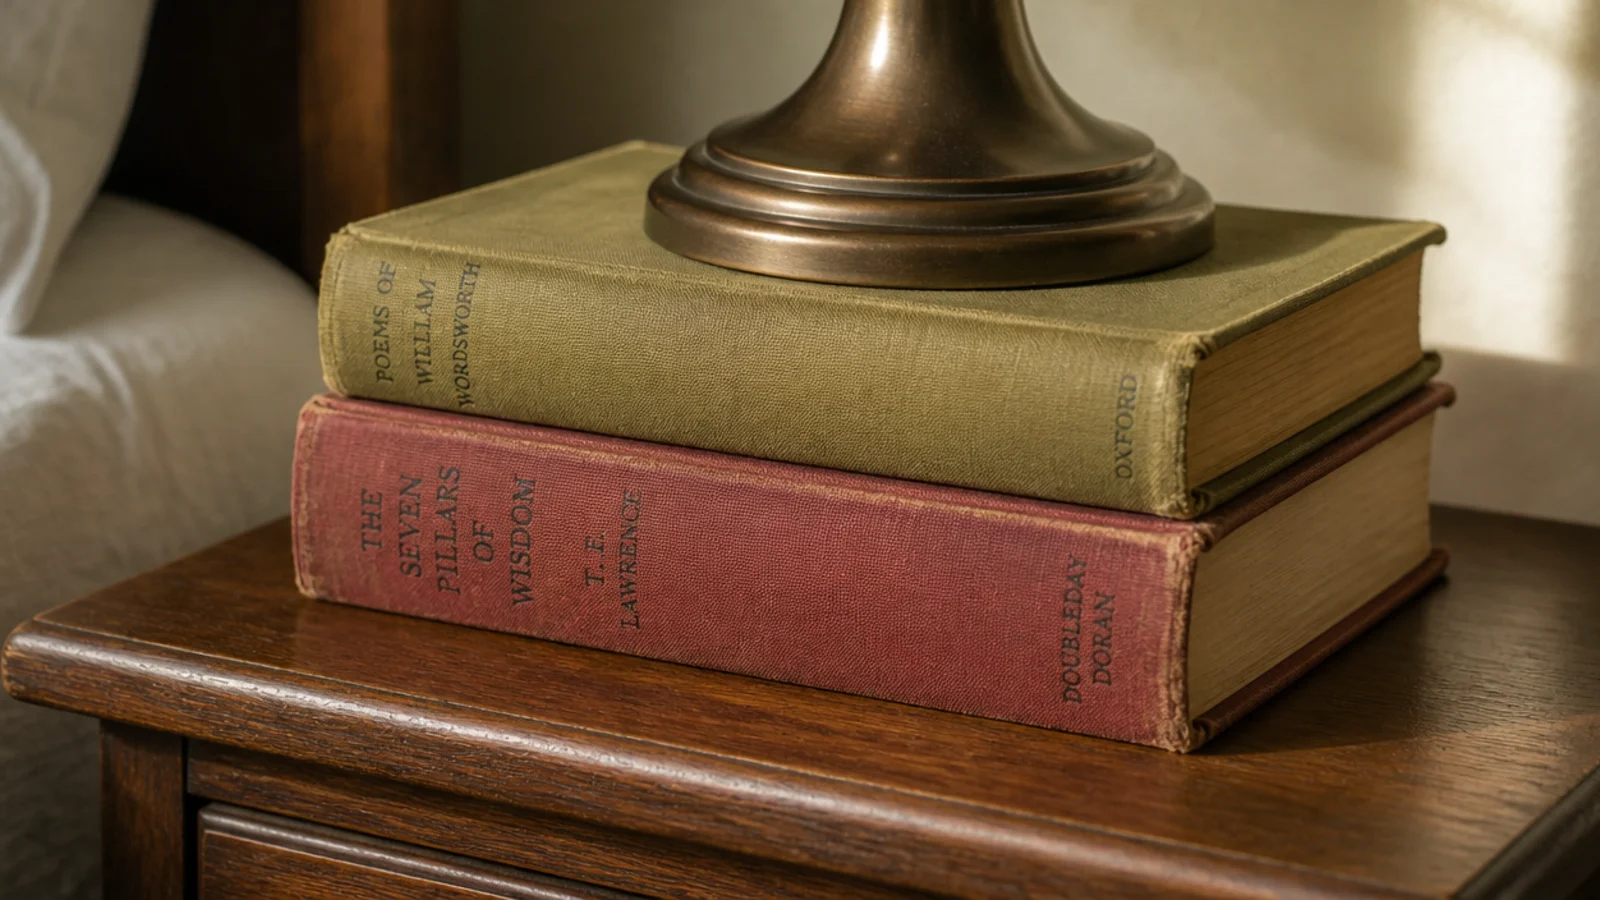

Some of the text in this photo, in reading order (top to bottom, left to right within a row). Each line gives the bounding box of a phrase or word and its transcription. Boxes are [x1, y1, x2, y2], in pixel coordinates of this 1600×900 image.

[373, 261, 397, 383] POEMS OF
[453, 261, 481, 408] WORDSWORTH
[1114, 374, 1138, 480] OXFORD
[361, 488, 383, 552] THE
[399, 474, 423, 578] SEVEN
[434, 466, 461, 596] PILLARS
[472, 519, 495, 564] OF
[509, 472, 536, 606] WISDOM
[585, 563, 605, 587] T.
[618, 487, 643, 630] LAWRENCE
[1060, 553, 1087, 705] DOUBLEDAY
[1091, 590, 1116, 686] DORAN
